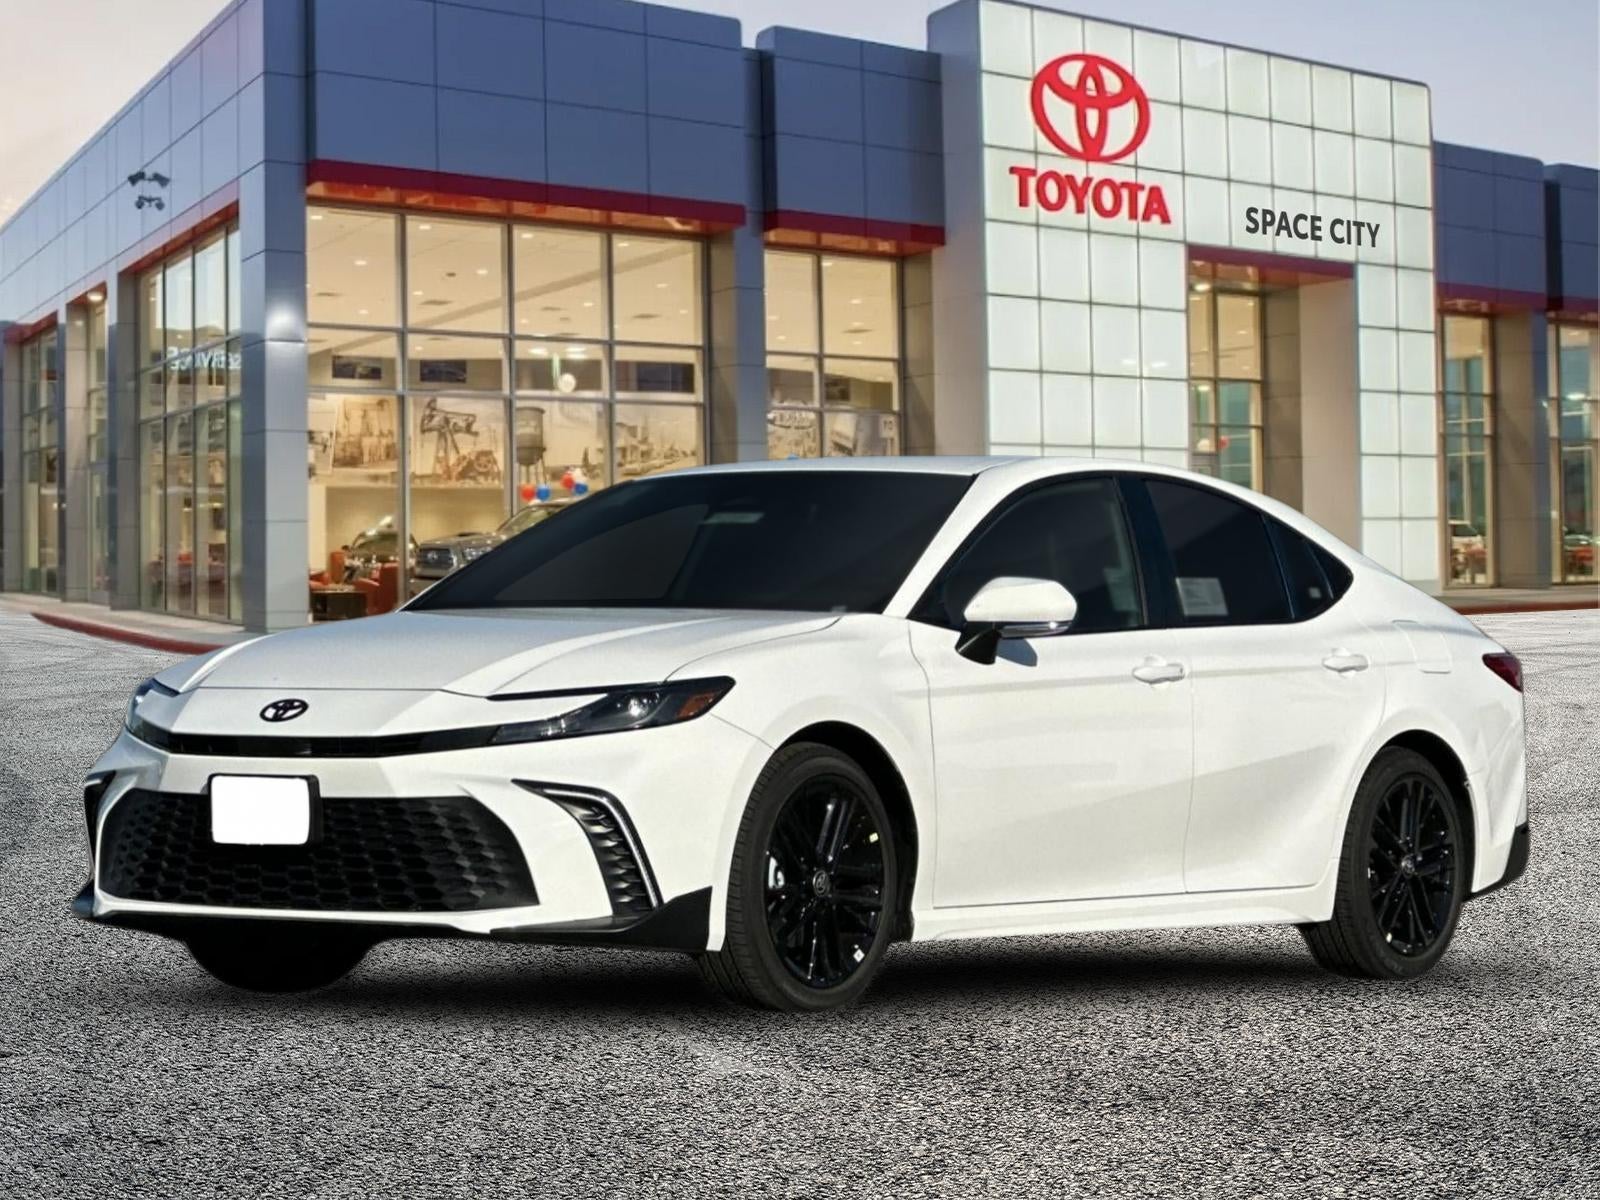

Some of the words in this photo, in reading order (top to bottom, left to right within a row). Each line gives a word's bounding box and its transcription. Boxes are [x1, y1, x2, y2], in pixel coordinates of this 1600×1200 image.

[1009, 166, 1172, 225] TOYOTA
[1245, 206, 1323, 242] SPACE
[1329, 218, 1381, 248] CITY
